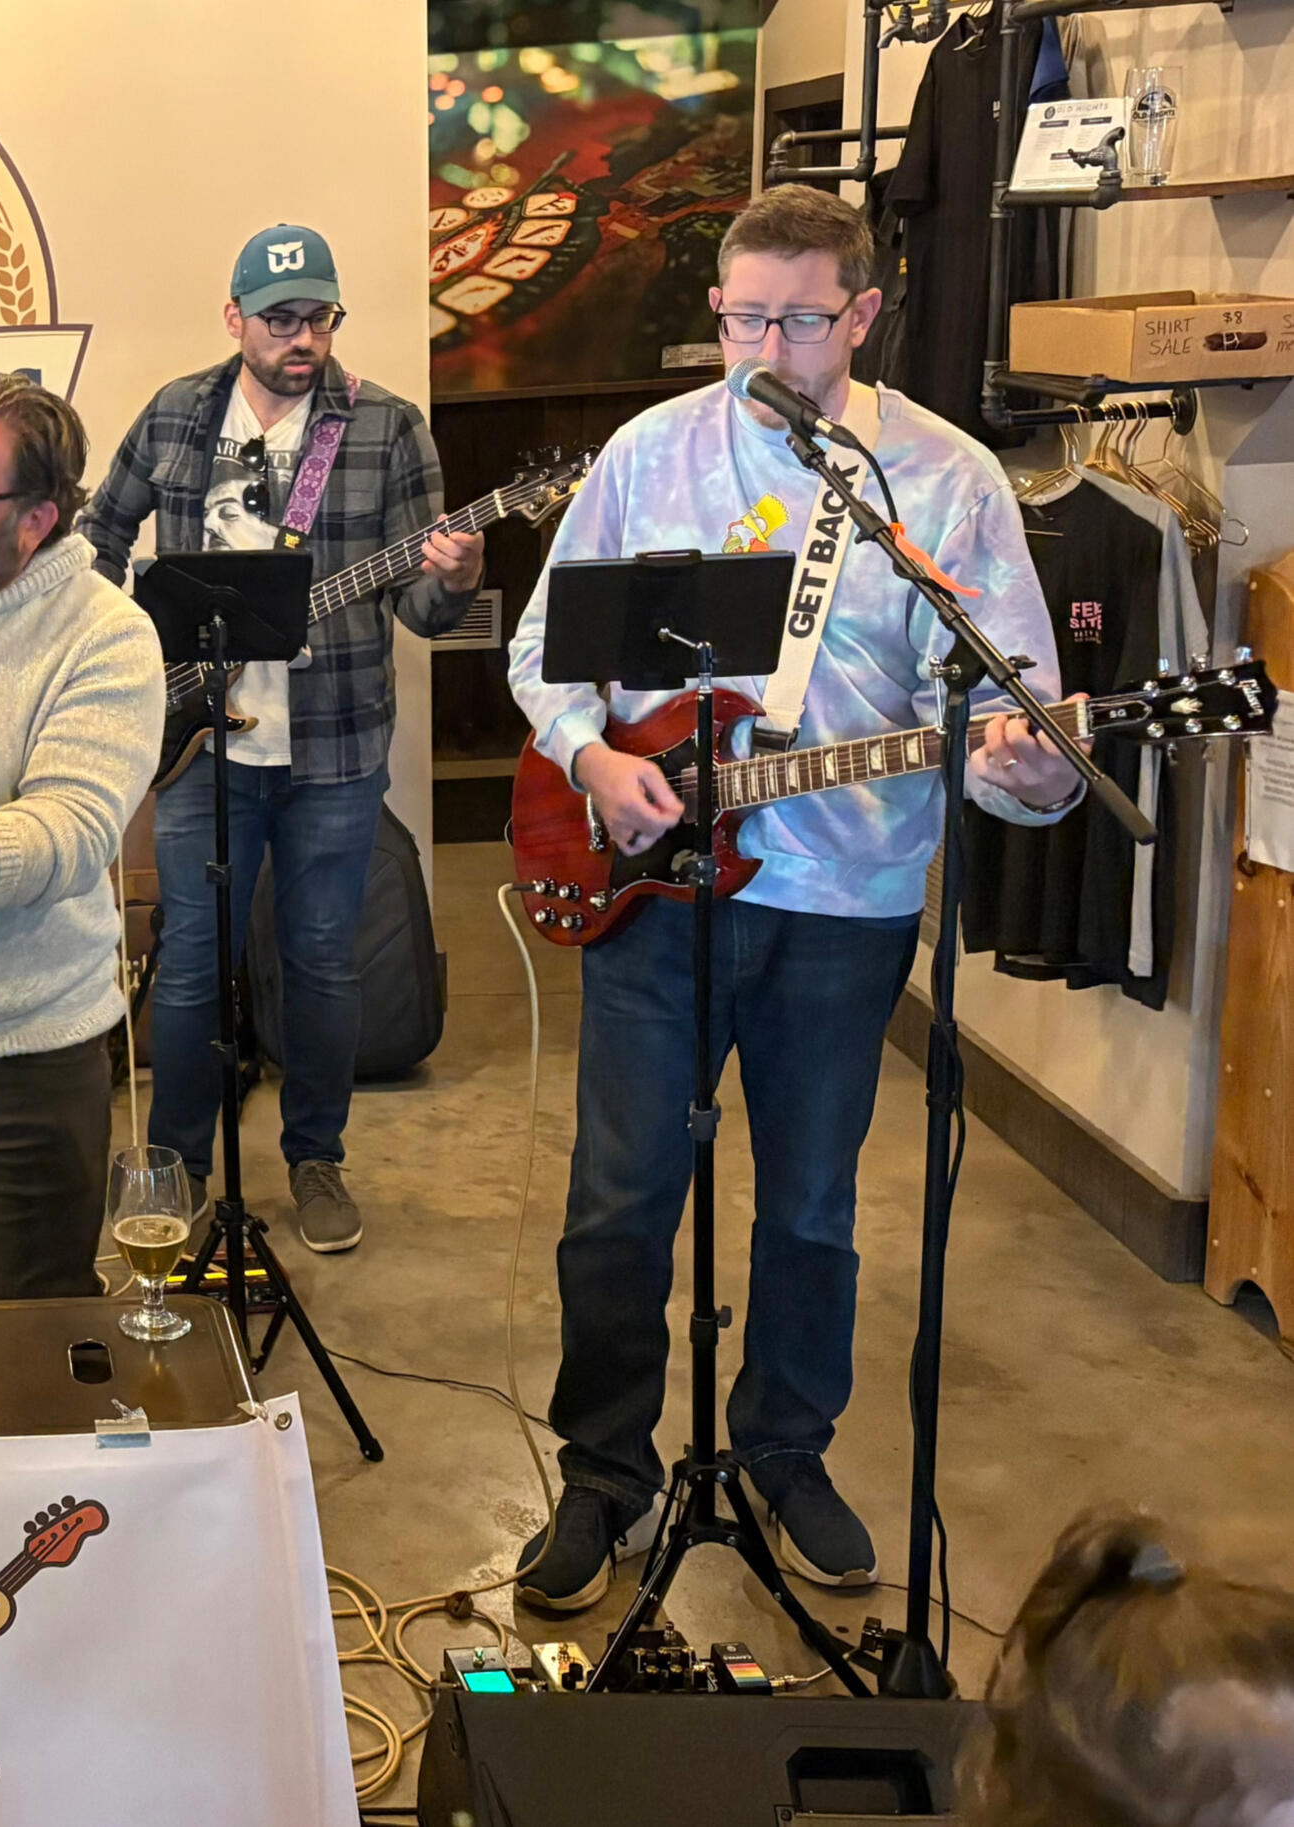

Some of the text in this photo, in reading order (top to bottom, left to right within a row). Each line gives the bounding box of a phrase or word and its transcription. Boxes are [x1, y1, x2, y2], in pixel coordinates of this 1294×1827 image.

[1145, 317, 1195, 336] SHIRT
[1222, 310, 1243, 325] $8
[1149, 336, 1194, 356] SALE
[788, 567, 828, 639] GET
[1109, 708, 1128, 719] SG
